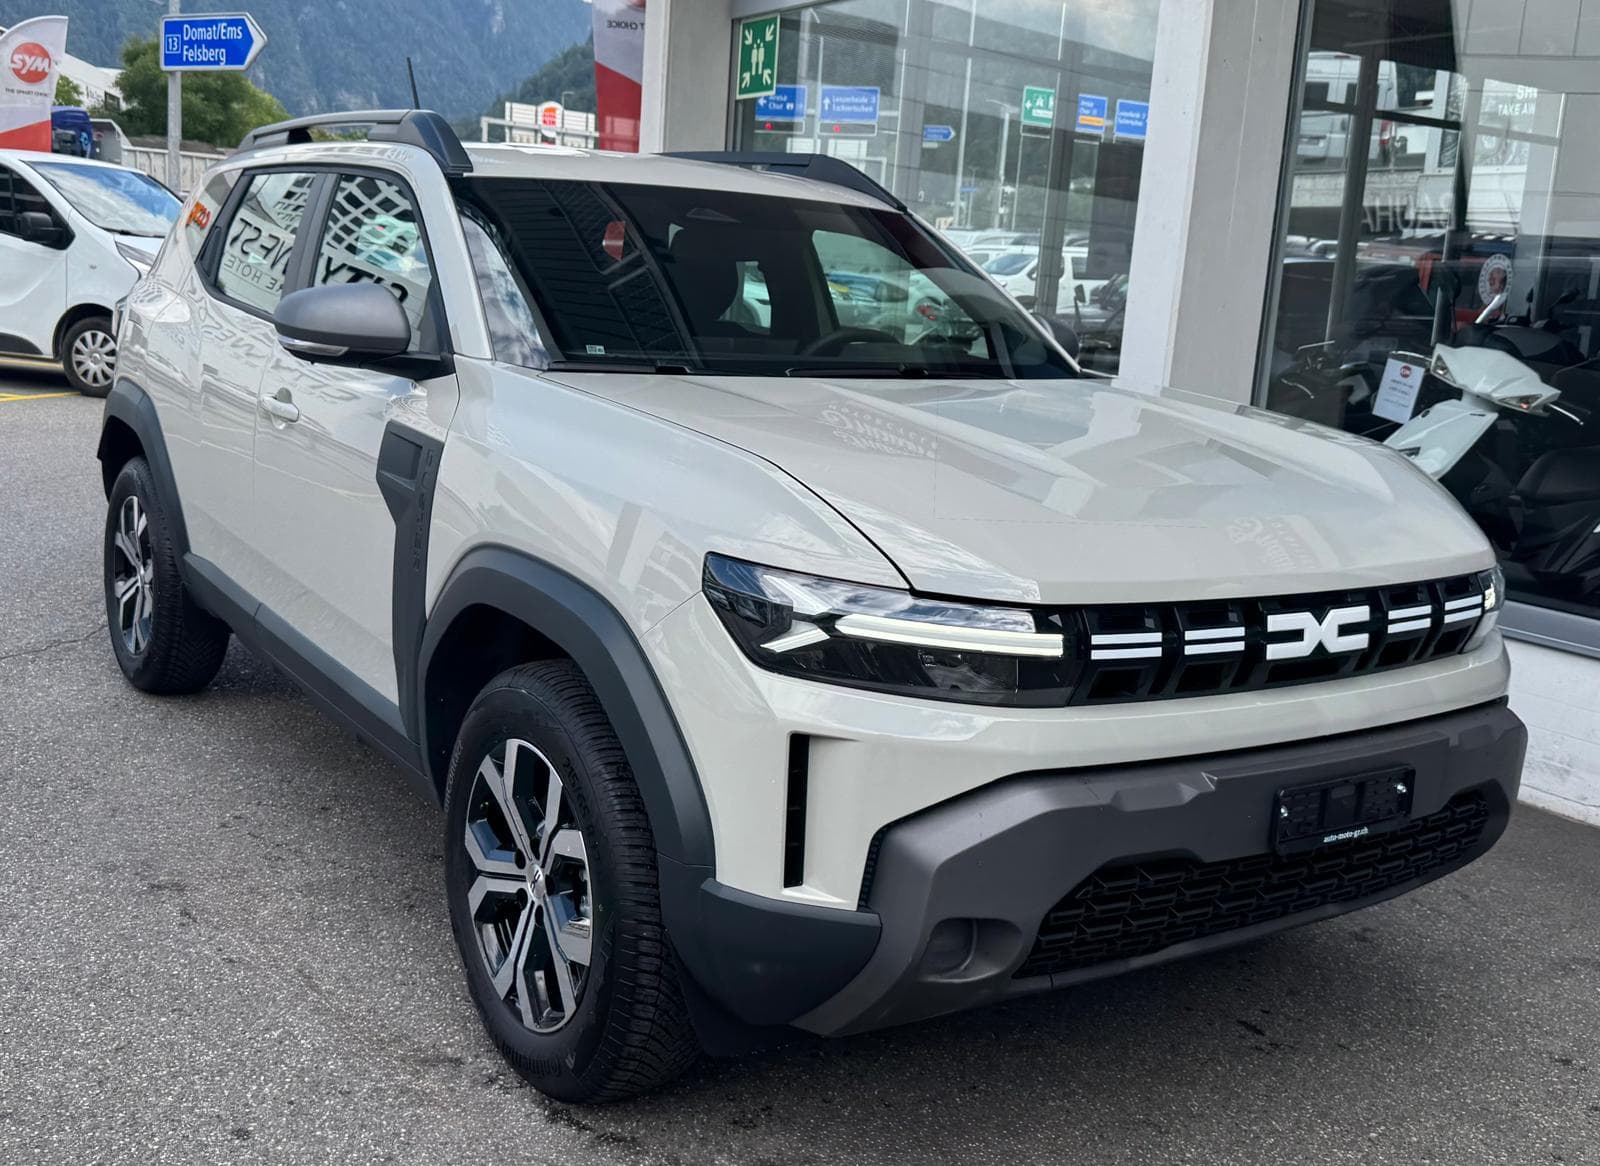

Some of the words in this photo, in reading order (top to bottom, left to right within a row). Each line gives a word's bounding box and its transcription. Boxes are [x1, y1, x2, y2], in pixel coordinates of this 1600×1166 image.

[183, 23, 243, 41] Domat/Ems
[168, 37, 179, 51] 13
[183, 46, 226, 64] Felsberg
[10, 54, 50, 75] SYM
[1498, 103, 1520, 116] TAKE
